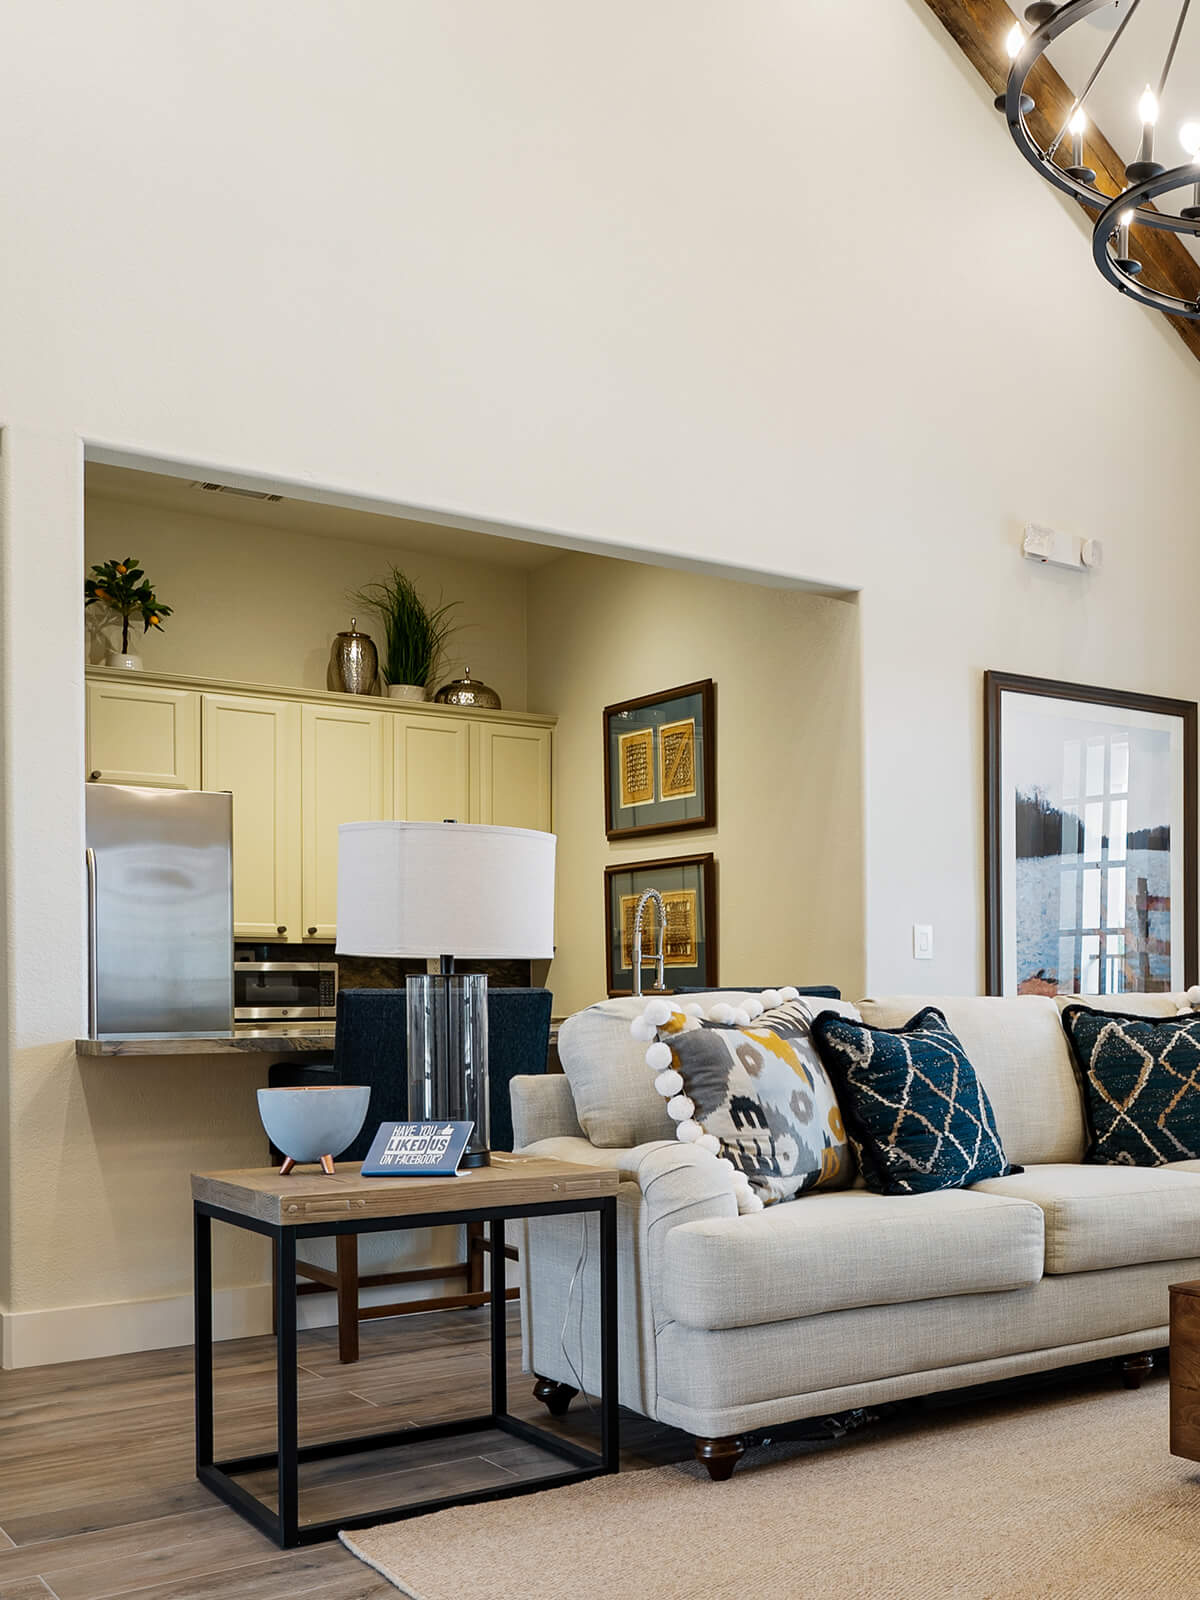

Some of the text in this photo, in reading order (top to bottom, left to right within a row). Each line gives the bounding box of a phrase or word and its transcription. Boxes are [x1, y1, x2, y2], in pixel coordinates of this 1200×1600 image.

[392, 1125, 438, 1136] HAVE YOU
[387, 1139, 448, 1151] LIKED US
[380, 1154, 443, 1165] ON FACEBOOK?
